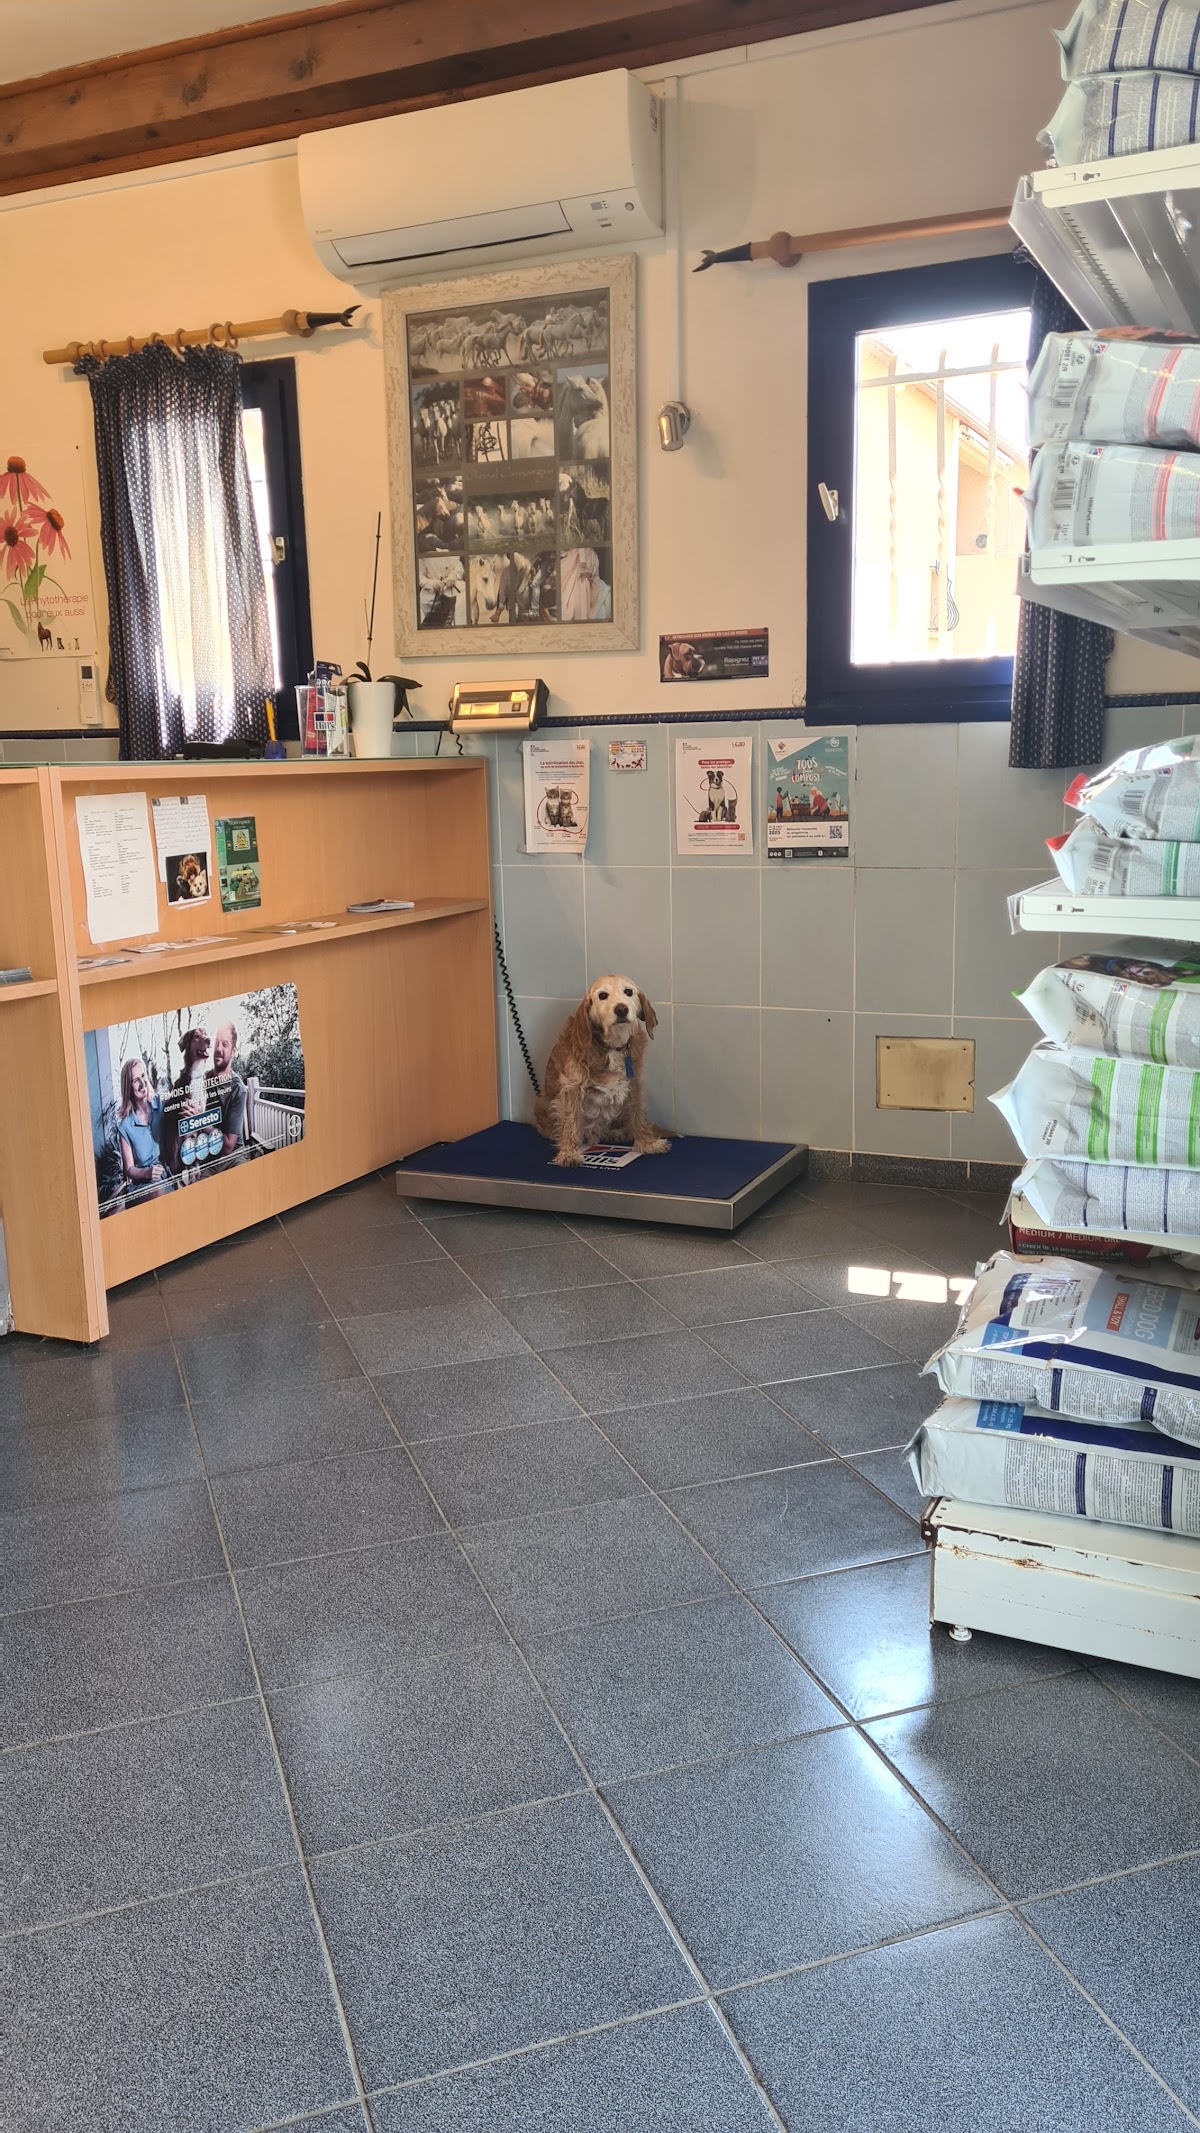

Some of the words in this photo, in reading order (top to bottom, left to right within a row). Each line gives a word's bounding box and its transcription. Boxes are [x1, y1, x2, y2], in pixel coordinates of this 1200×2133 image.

[1086, 496, 1094, 536] HillsPet.com
[46, 610, 62, 618] eux
[64, 606, 86, 616] aussi
[316, 722, 335, 730] Hill's
[797, 757, 818, 770] TOUS
[195, 1073, 232, 1092] PROTECTION
[164, 1103, 180, 1113] contre
[218, 1086, 232, 1096] tiques
[189, 1112, 219, 1130] Seresto
[582, 1156, 618, 1164] ill's
[1019, 1227, 1055, 1238] MEDIUM
[1066, 1232, 1101, 1242] MEDIUM
[1116, 1295, 1128, 1313] SMALL
[1110, 1315, 1122, 1328] TOY
[1136, 1312, 1156, 1340] DOG
